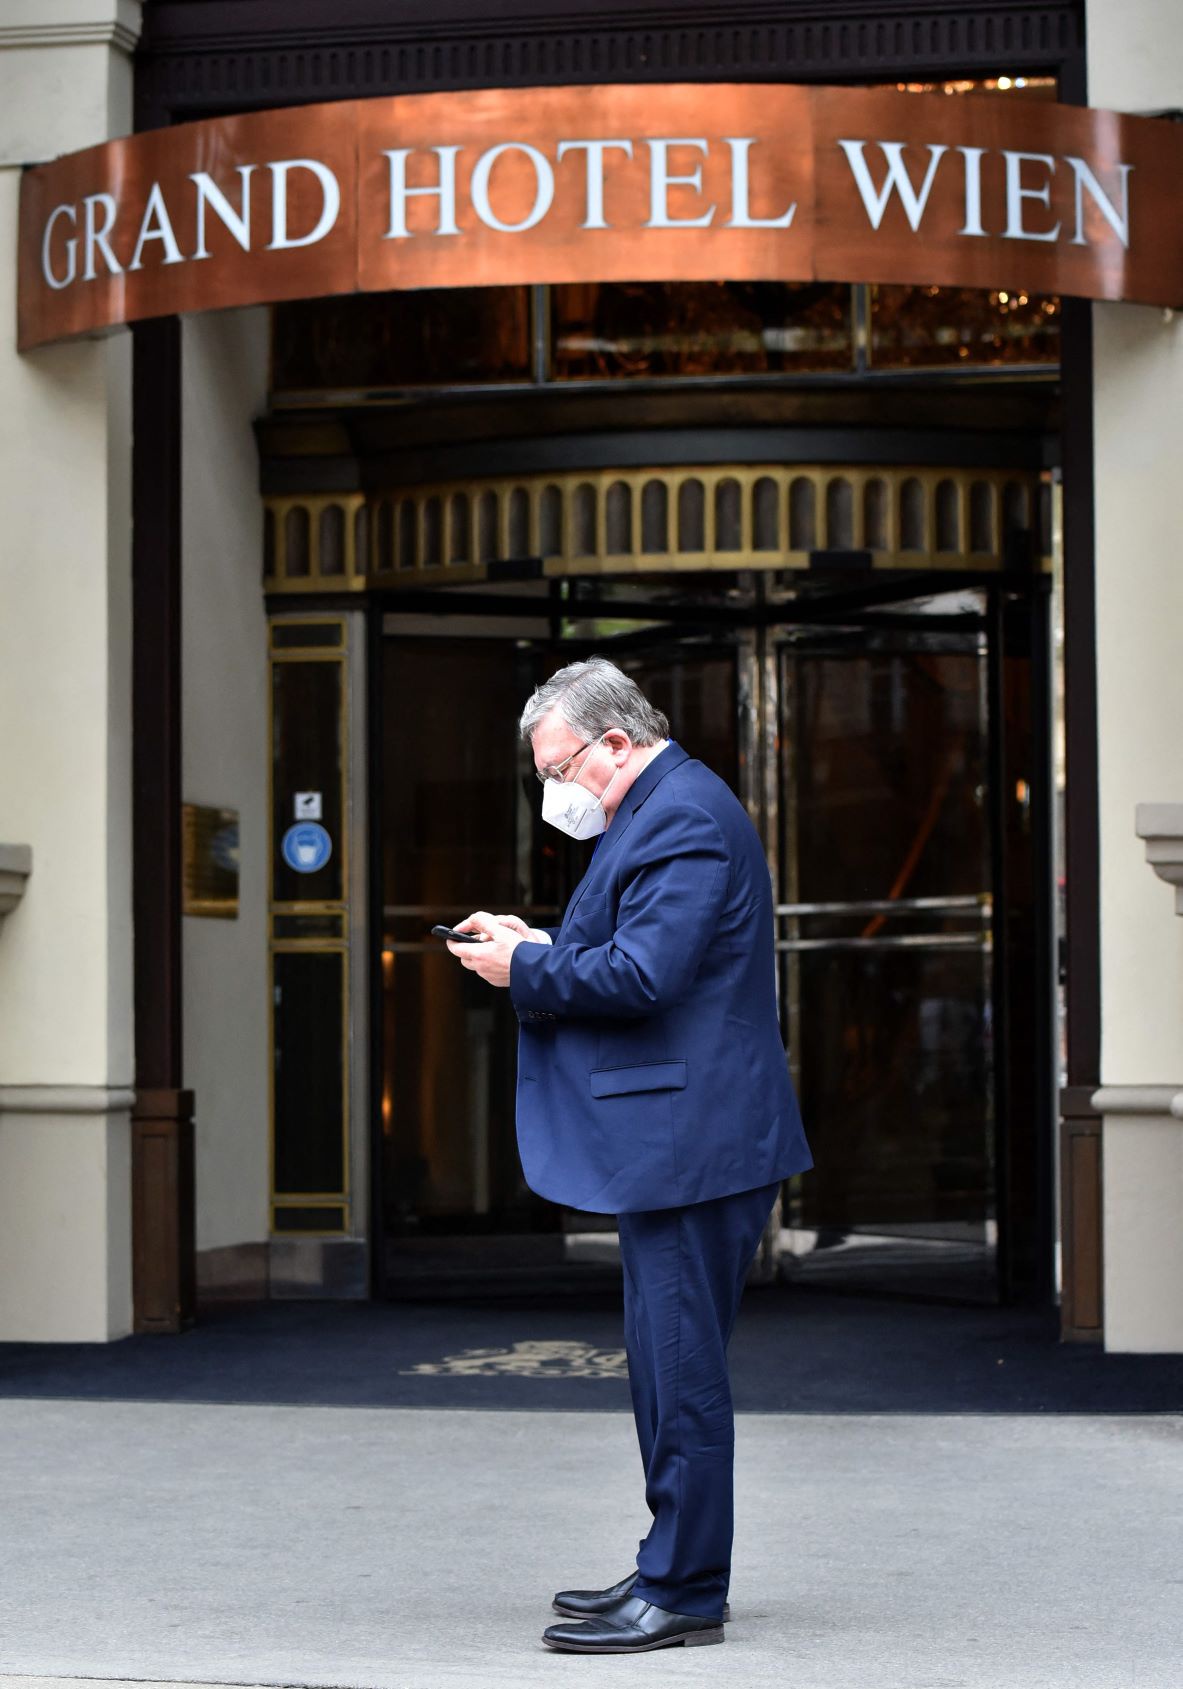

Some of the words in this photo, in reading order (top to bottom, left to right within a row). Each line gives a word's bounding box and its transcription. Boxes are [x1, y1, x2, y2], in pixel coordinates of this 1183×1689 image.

[41, 158, 341, 290] GRAND
[382, 137, 797, 239] HOTEL
[837, 139, 1135, 249] WIEN
